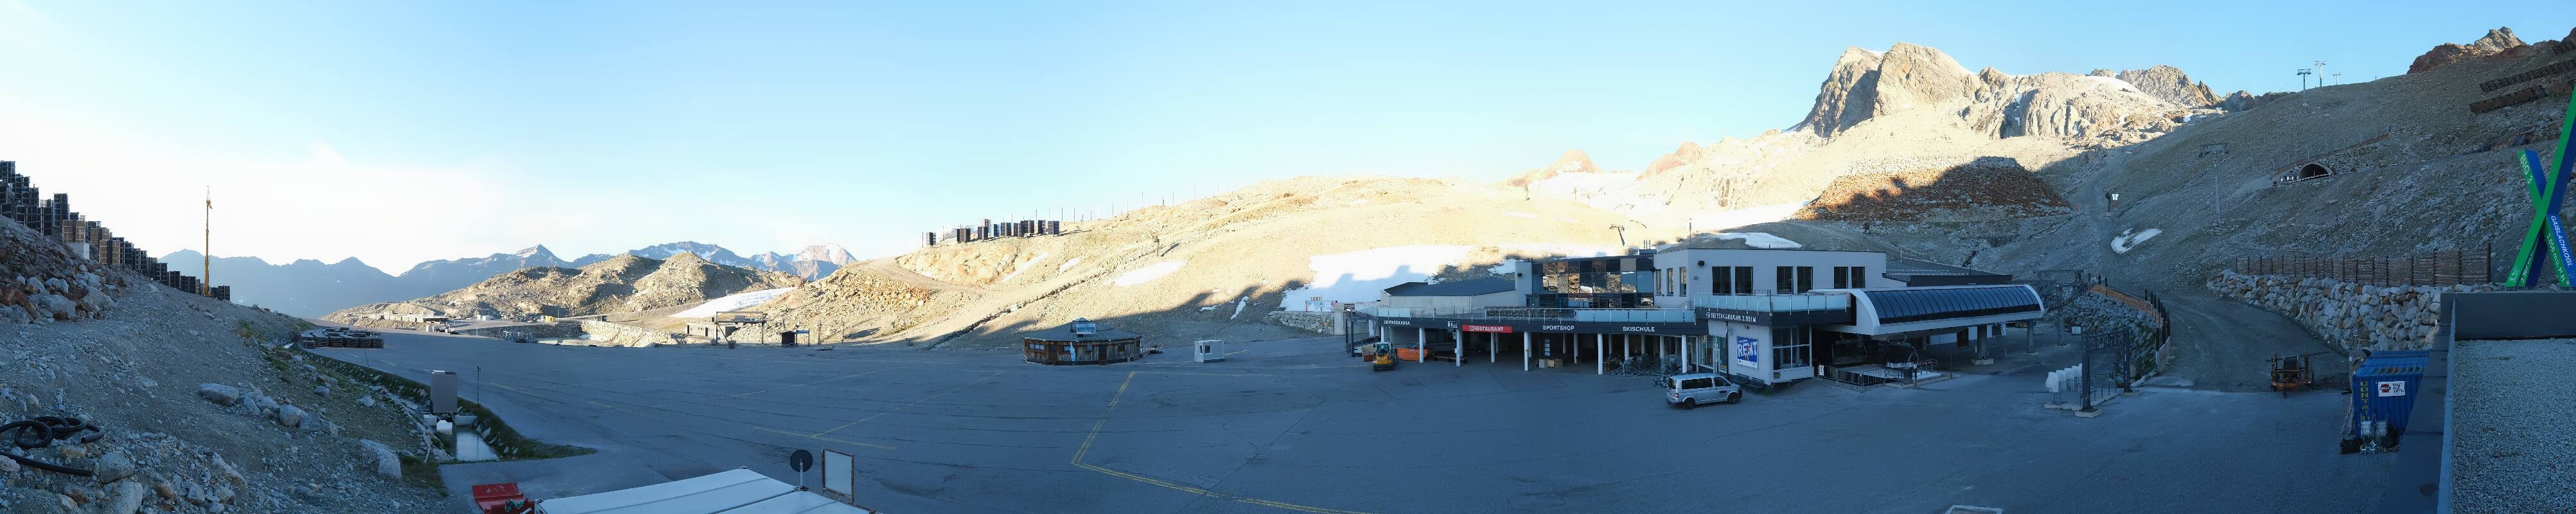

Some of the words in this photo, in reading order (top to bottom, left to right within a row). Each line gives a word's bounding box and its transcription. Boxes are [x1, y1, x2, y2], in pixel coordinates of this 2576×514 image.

[2520, 154, 2530, 175] BIG
[2527, 175, 2533, 184] 3
[2551, 215, 2573, 267] GAISLACHKOGL
[1738, 341, 1758, 357] RENT
